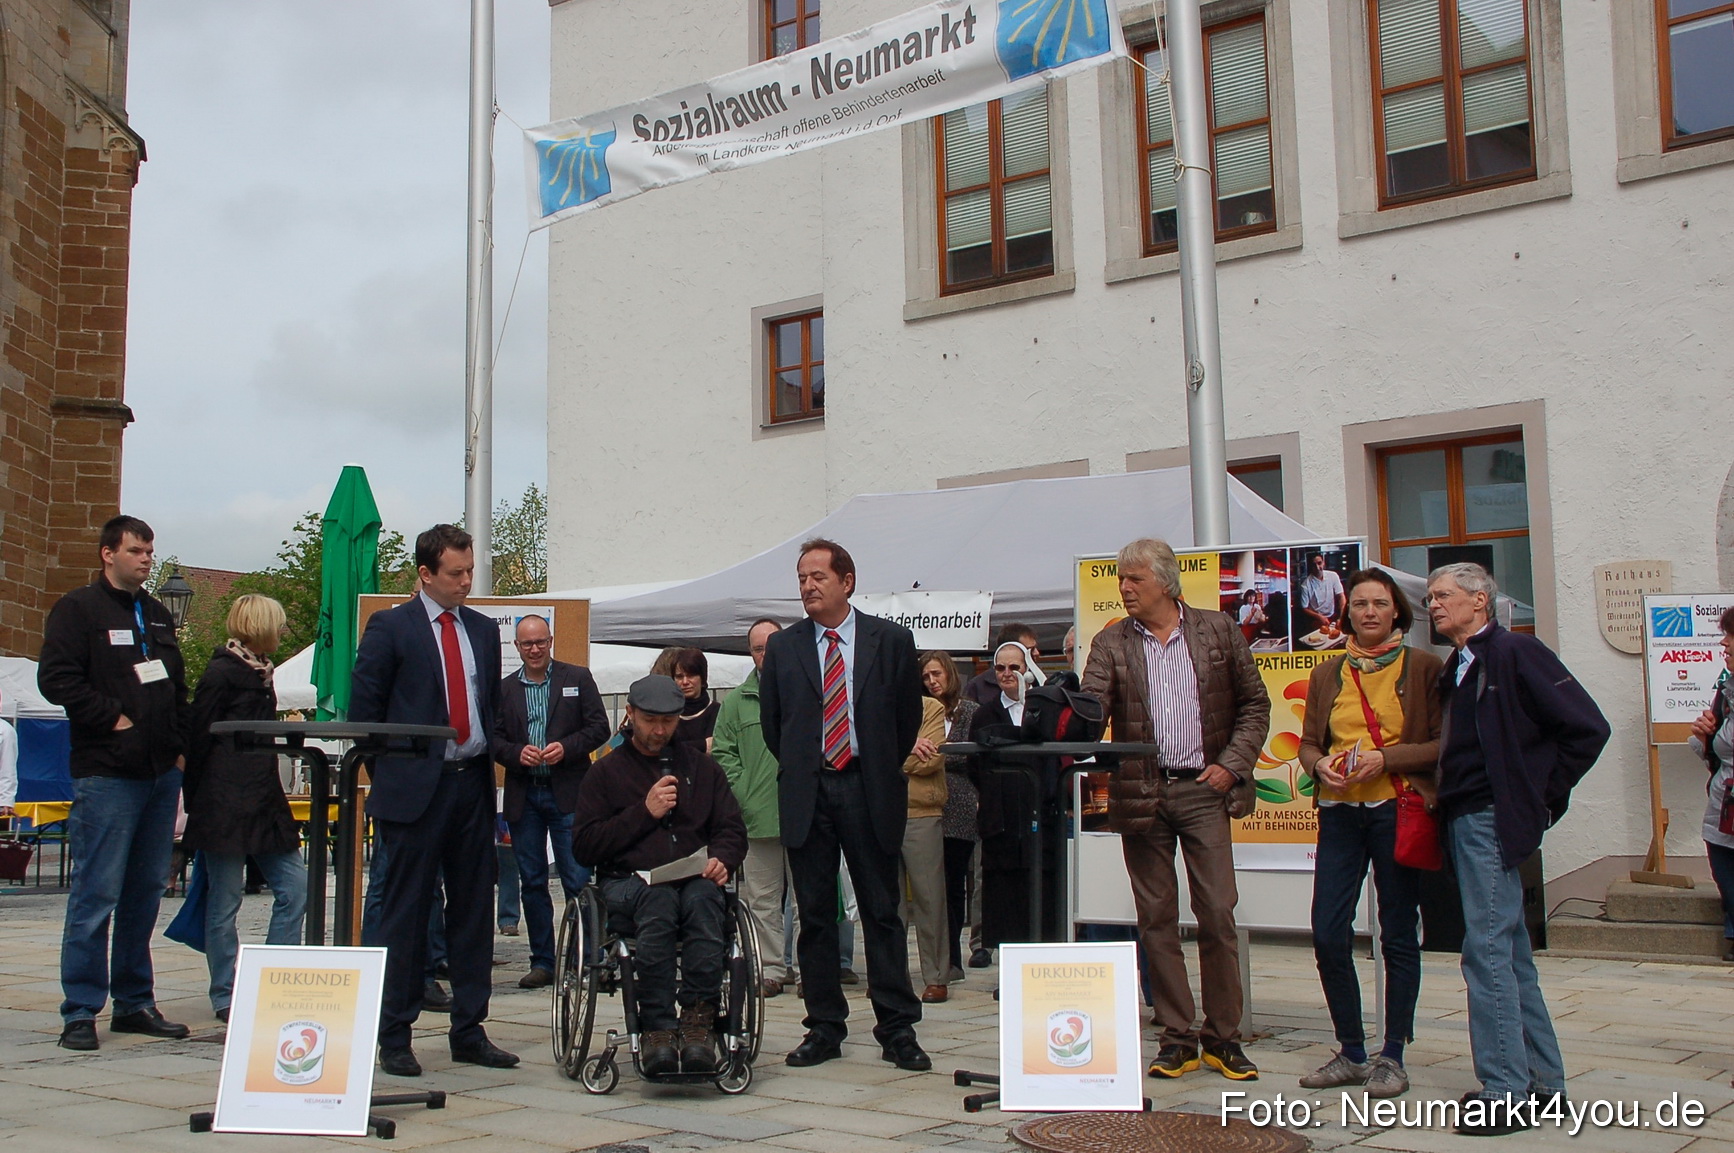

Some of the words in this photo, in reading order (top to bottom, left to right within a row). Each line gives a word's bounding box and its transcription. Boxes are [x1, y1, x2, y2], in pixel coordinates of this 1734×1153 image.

[631, 81, 788, 142] Sozialraum
[810, 4, 977, 100] Neumarkt
[652, 125, 789, 157] Arbeschaft
[792, 115, 832, 136] offene
[830, 68, 946, 121] Behindertenarbeit
[695, 152, 709, 166] im
[1091, 564, 1118, 578] SYM
[1178, 558, 1207, 573] UME
[1604, 569, 1661, 582] Rathaus
[1093, 601, 1125, 612] BEIRA
[1695, 604, 1728, 616] Sozialra
[876, 611, 982, 630] indertenarbeit
[1250, 809, 1271, 820] FÜR
[1273, 810, 1318, 820] MENSCH
[1241, 821, 1262, 831] MIT
[1265, 821, 1318, 831] BEHINDER
[1031, 966, 1107, 979] URKUNDE
[269, 972, 351, 987] URKUNDE
